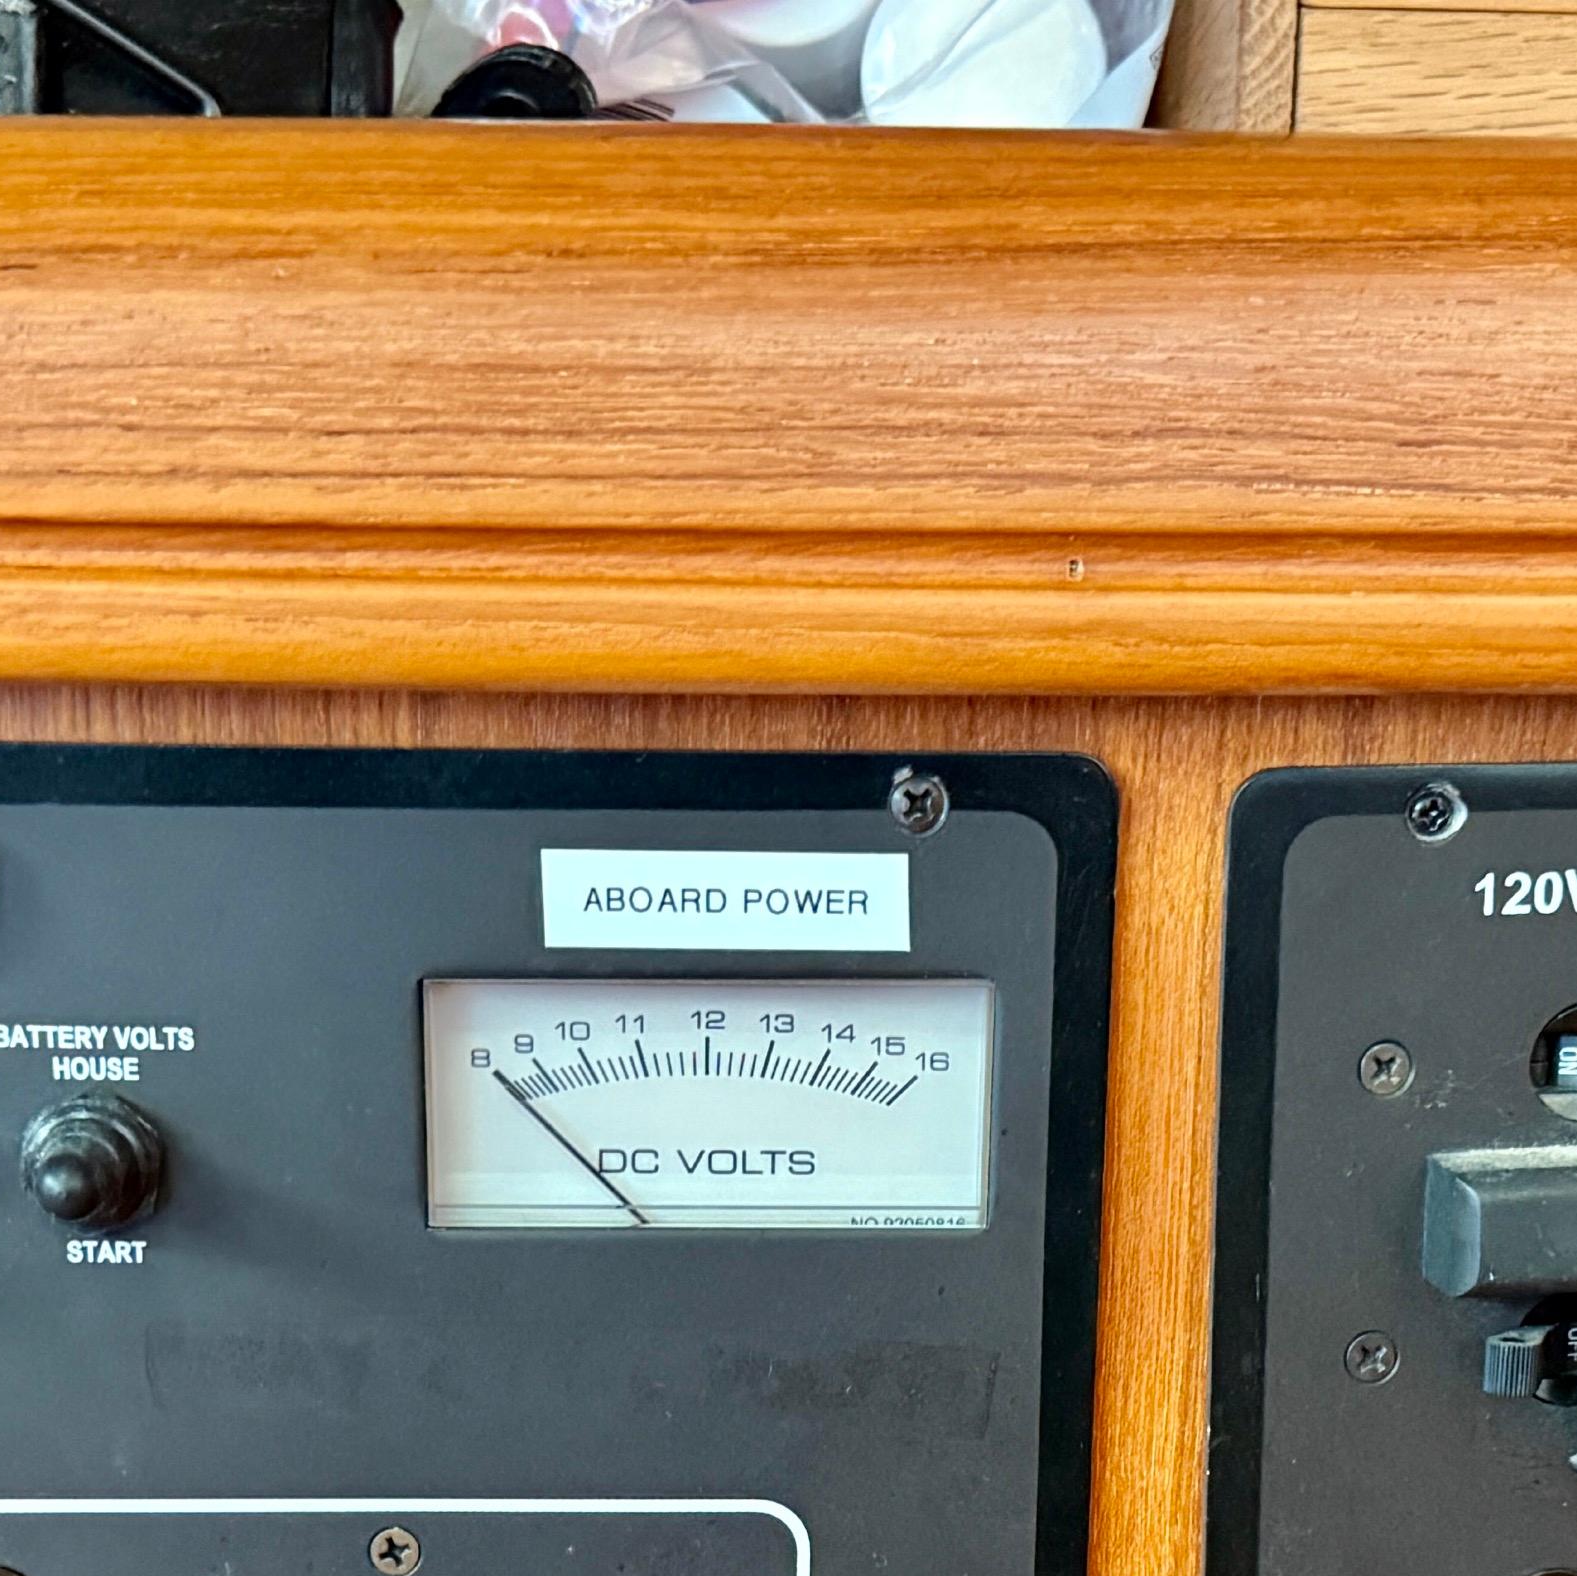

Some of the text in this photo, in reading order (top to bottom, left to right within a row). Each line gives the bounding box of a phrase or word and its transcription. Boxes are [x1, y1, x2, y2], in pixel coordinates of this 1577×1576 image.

[584, 886, 869, 916] ABOARD POWER
[615, 1015, 646, 1034] 11
[691, 1010, 726, 1030] 12
[760, 1013, 795, 1034] 13
[111, 1026, 195, 1051] VOLTS
[555, 1021, 591, 1042] 10
[820, 1023, 856, 1044] 14
[514, 1034, 535, 1054] 9
[870, 1036, 906, 1056] 15
[471, 1048, 492, 1068] 8
[914, 1051, 950, 1072] 16
[52, 1056, 140, 1082] HOUSE
[598, 1148, 816, 1176] DC VOLTS
[65, 1241, 147, 1264] START
